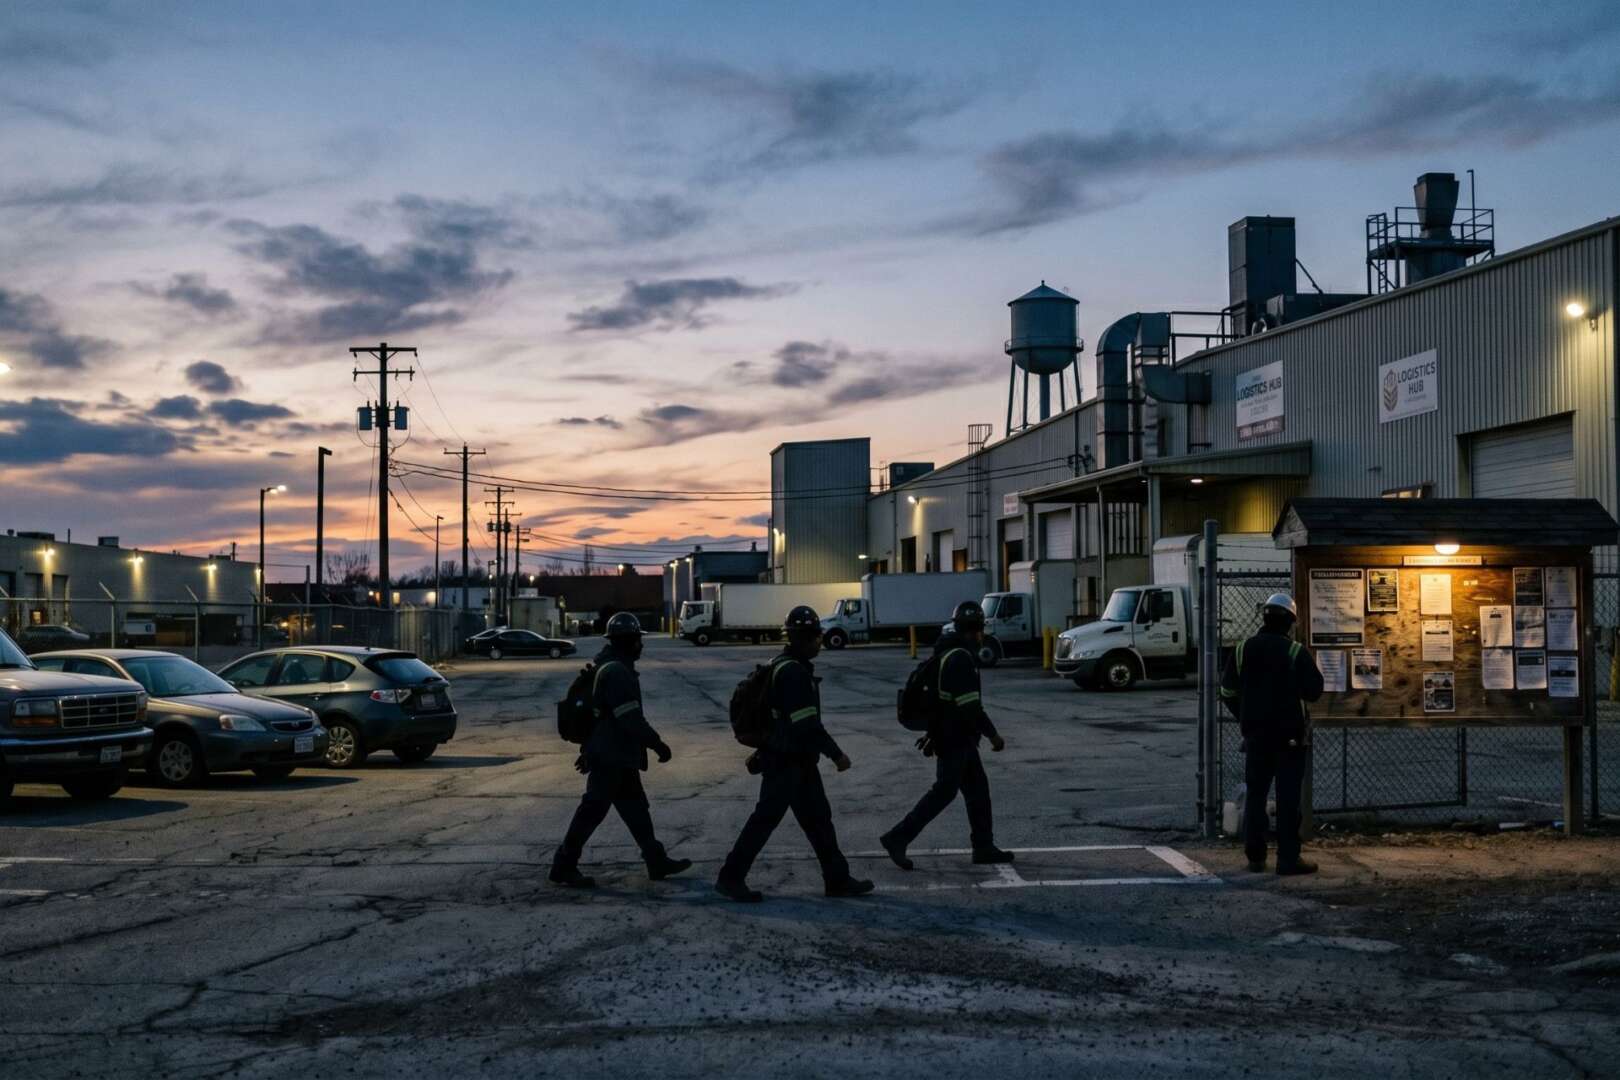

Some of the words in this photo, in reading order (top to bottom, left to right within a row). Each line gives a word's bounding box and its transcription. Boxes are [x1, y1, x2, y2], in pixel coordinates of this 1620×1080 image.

[1397, 362, 1435, 384] LOGISTICS
[1237, 381, 1267, 401] LOGISTICS
[1269, 376, 1282, 392] HUB
[1408, 379, 1424, 394] HUB
